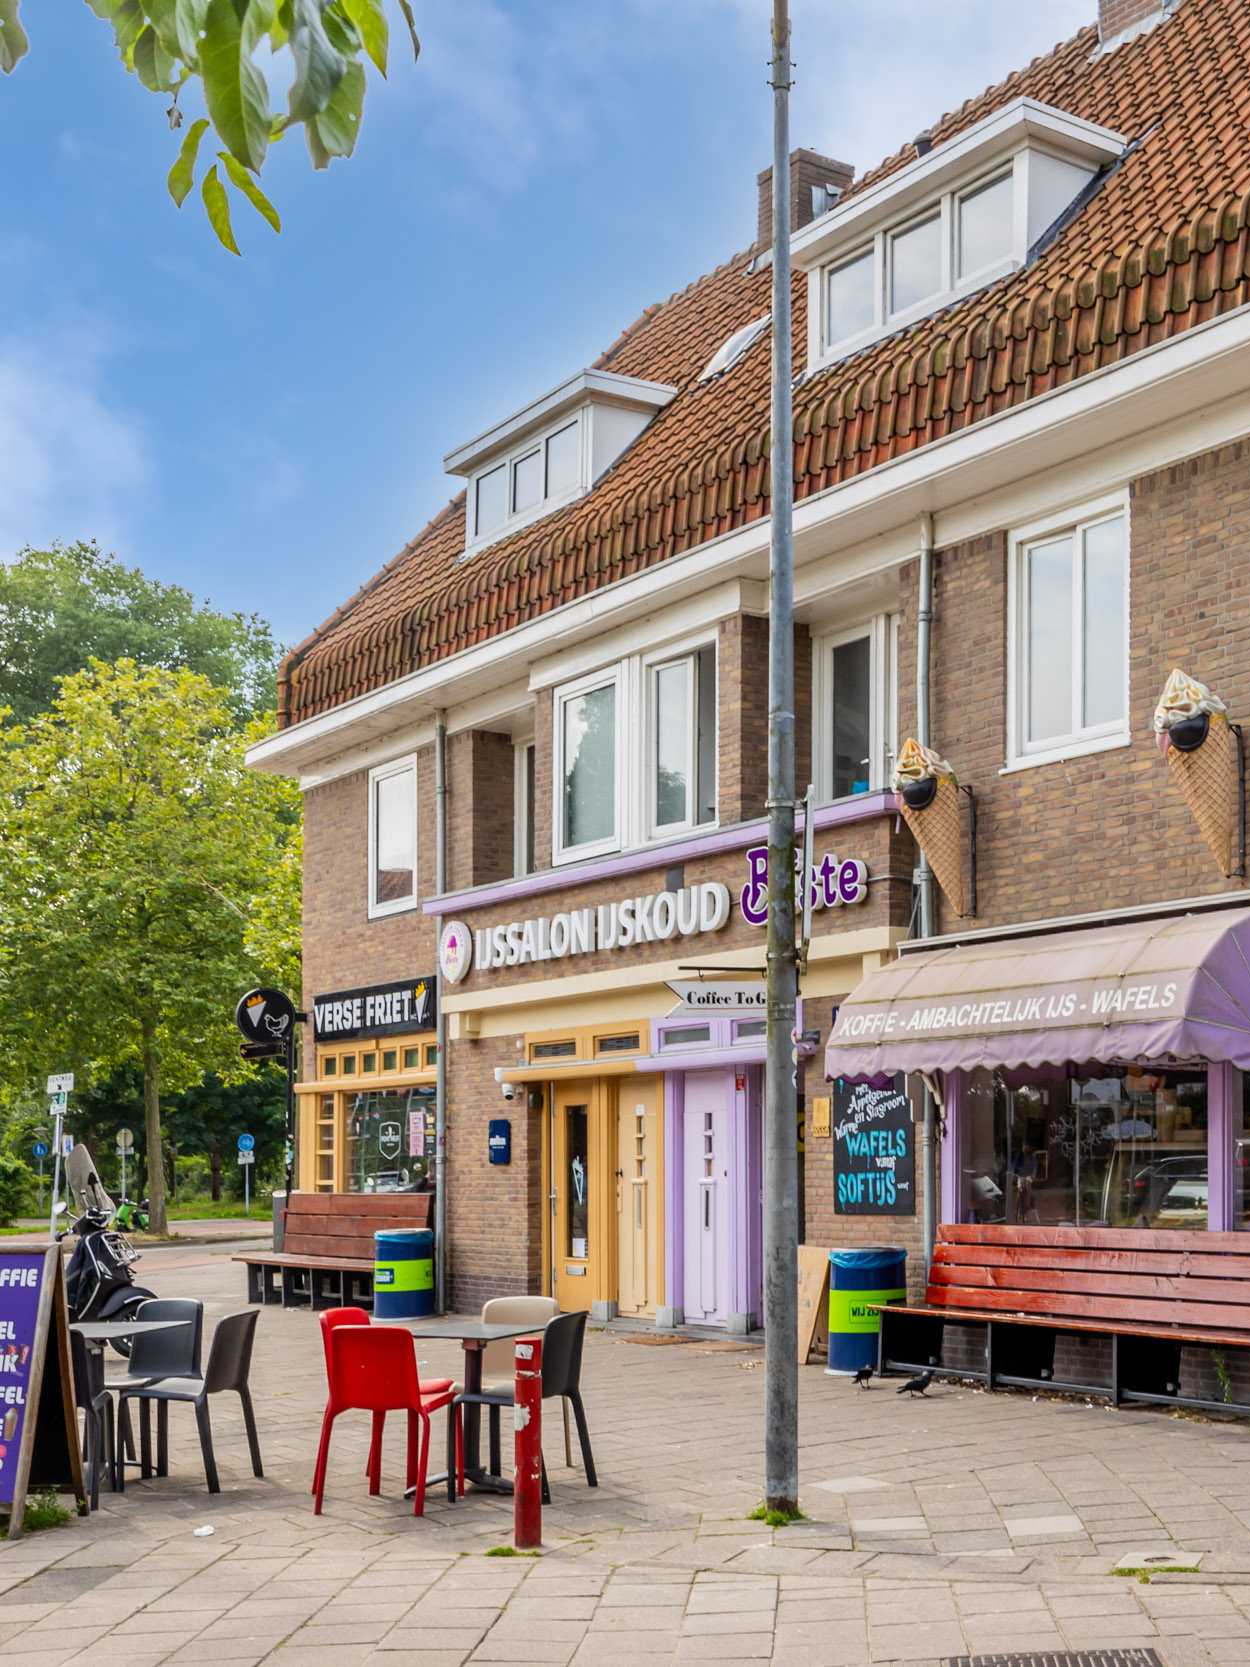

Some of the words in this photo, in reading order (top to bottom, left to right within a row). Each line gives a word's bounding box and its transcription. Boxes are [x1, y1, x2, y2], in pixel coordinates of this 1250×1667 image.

[741, 846, 868, 926] Bste
[475, 908, 595, 970] IJSSALON
[597, 882, 731, 950] IJSKOUD
[314, 998, 362, 1034] VERSE
[365, 989, 412, 1027] FRIET
[686, 991, 732, 1005] Coffee
[734, 992, 755, 1005] To
[755, 991, 767, 1005] G
[839, 1011, 899, 1037] KOFFIE
[906, 996, 1046, 1031] AMBACHTELIJK
[1045, 993, 1077, 1018] IJS
[1091, 982, 1177, 1014] WAFELS
[845, 1128, 907, 1158] WAFELS
[851, 1306, 866, 1317] WIJ
